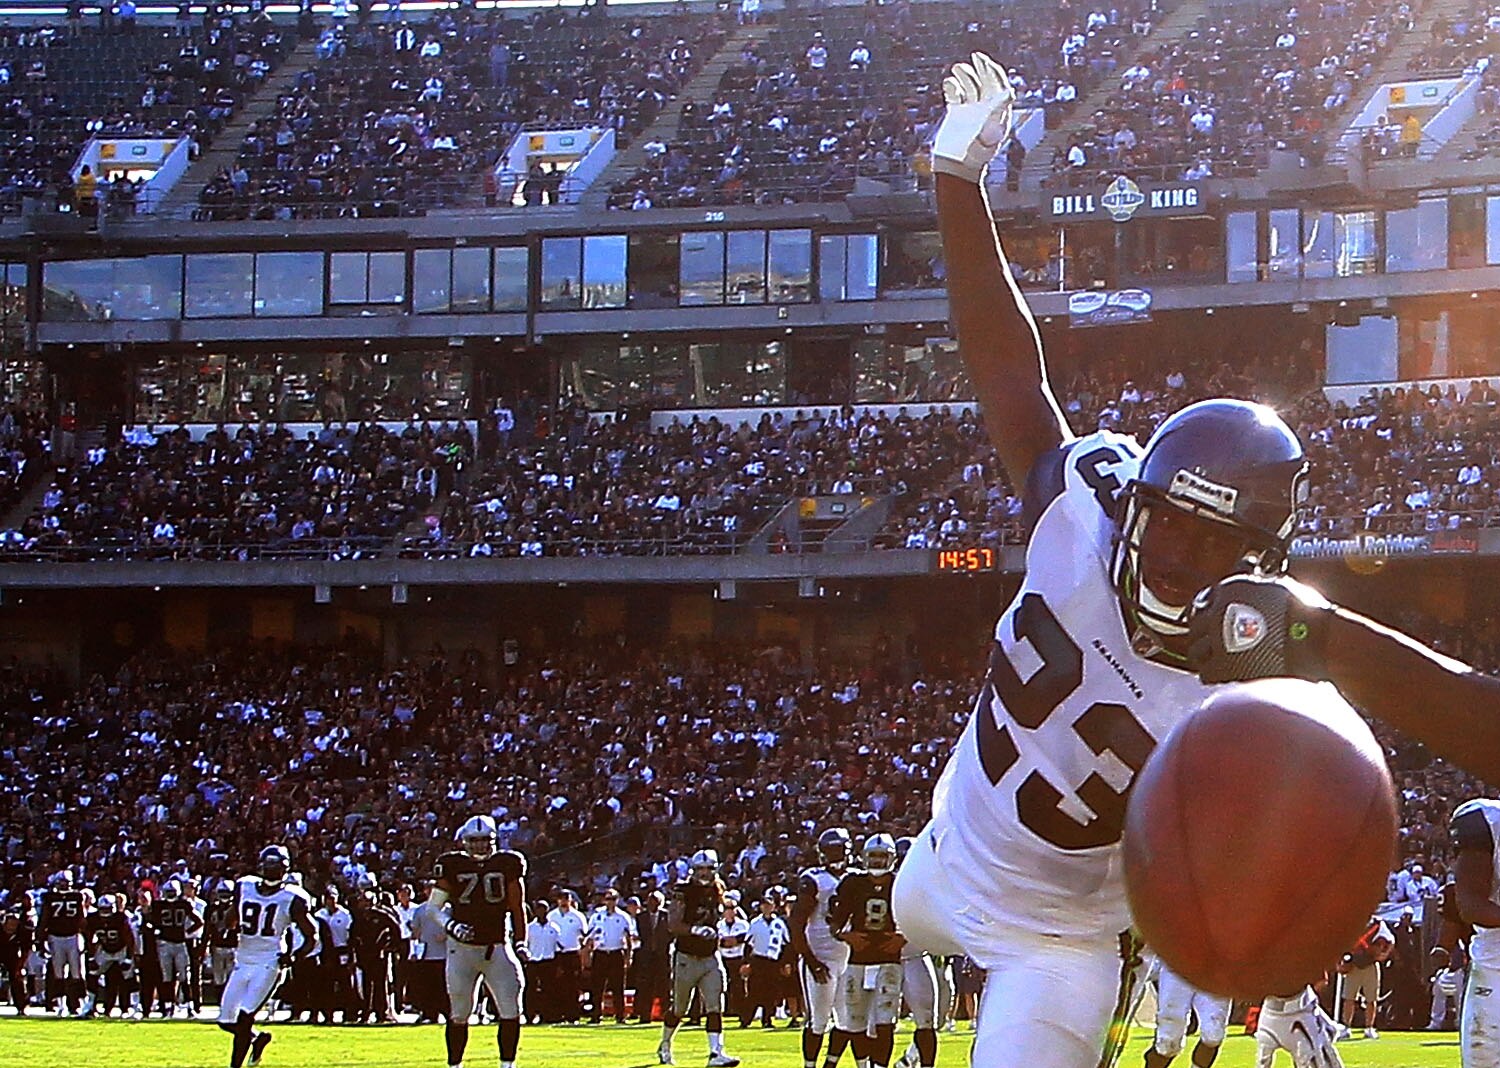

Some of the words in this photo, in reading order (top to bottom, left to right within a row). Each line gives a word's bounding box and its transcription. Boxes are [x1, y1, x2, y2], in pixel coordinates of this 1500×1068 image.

[1053, 195, 1095, 214] BILL
[1151, 188, 1198, 208] KING
[939, 549, 992, 569] 14:57
[1092, 638, 1144, 699] SEAHAWKS
[977, 592, 1157, 850] 23
[456, 872, 506, 904] 70
[51, 901, 77, 917] 75
[161, 908, 186, 926] 20
[242, 901, 279, 937] 91
[864, 899, 888, 930] 8
